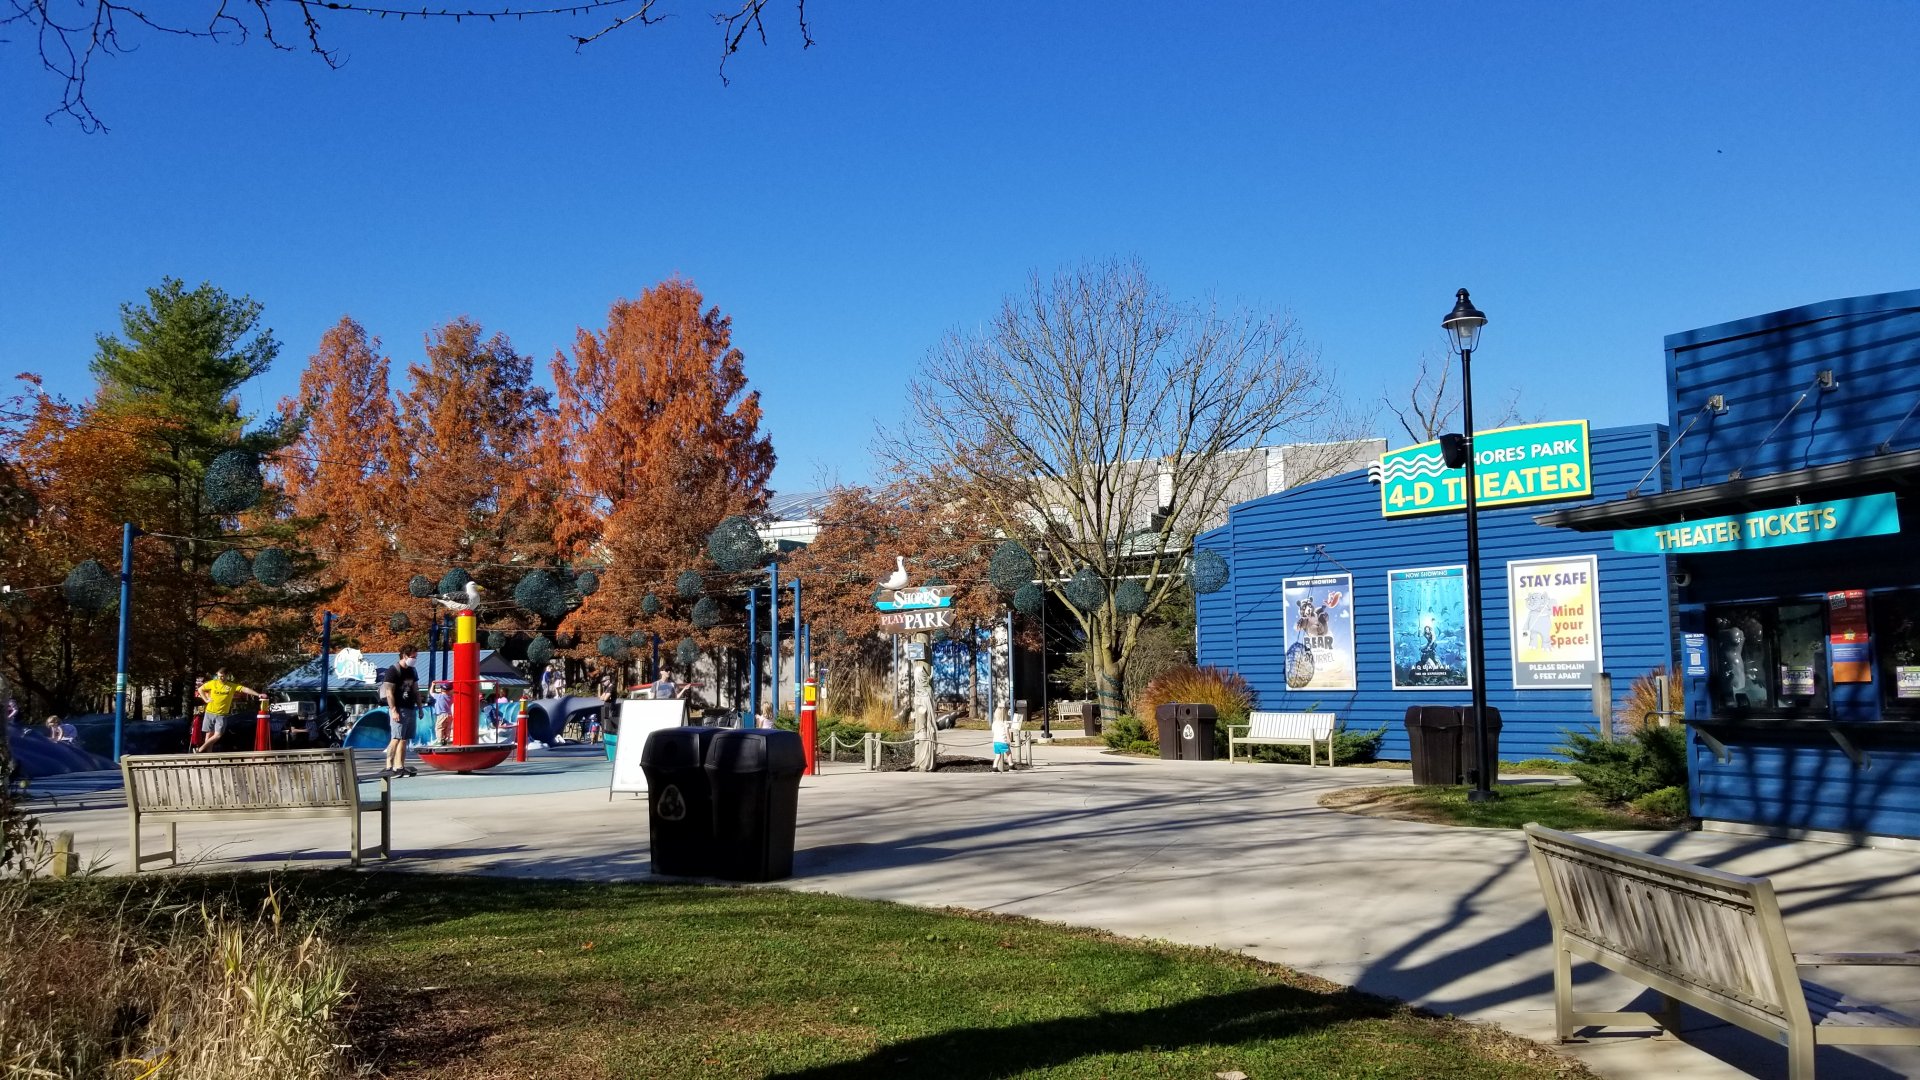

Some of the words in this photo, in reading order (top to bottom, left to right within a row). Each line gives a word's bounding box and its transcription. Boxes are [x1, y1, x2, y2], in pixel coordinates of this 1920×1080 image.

[1531, 438, 1578, 459] PARK
[1388, 481, 1435, 508] 4-D
[1442, 462, 1582, 502] THEATER
[1655, 520, 1741, 550] THEATER
[1746, 507, 1838, 539] TICKETS
[1519, 574, 1551, 588] STAY
[1554, 572, 1587, 586] SAFE
[893, 588, 942, 608] SHORES
[1552, 604, 1584, 617] Mind
[881, 614, 905, 626] PLAY
[904, 610, 951, 630] PARK
[1554, 621, 1584, 634] your
[1303, 636, 1333, 651] BEAR
[1550, 633, 1589, 649] Space!
[1529, 663, 1556, 671] PLEASE
[1556, 663, 1585, 671] REMAIN
[1557, 672, 1582, 680] APART
